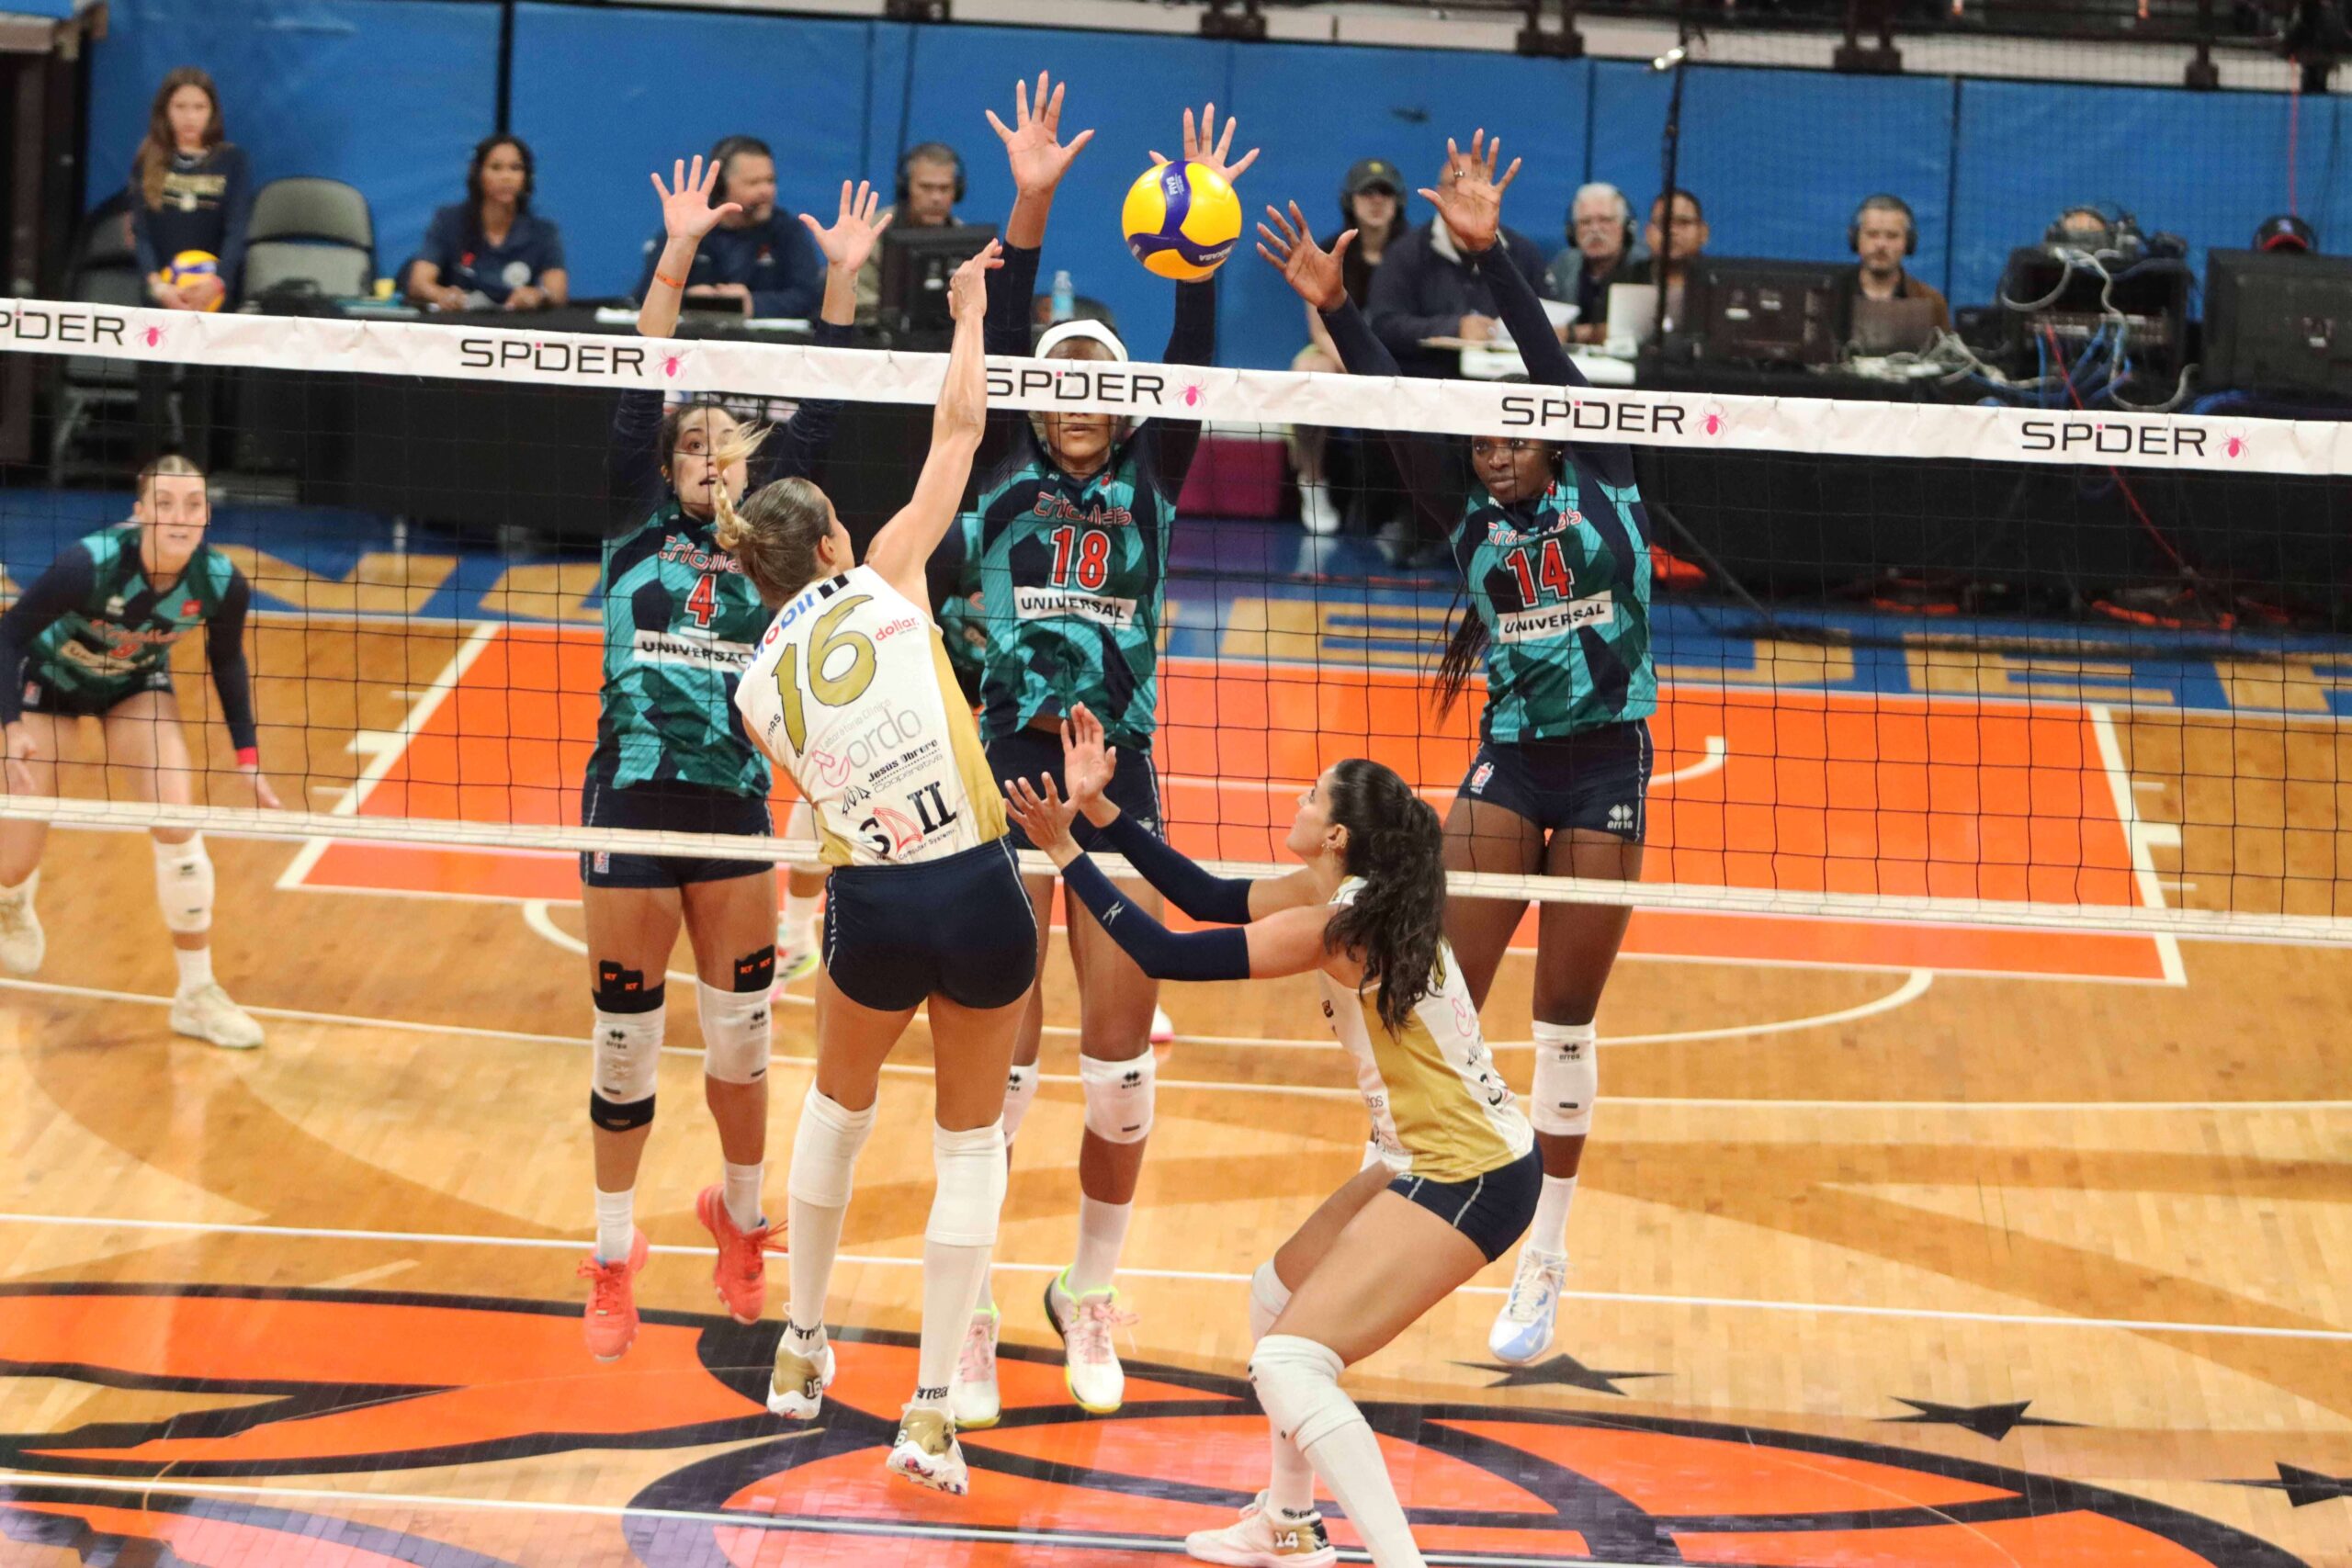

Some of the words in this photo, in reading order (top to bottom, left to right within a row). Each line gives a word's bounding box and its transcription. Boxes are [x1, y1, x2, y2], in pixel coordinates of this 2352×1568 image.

[659, 535, 743, 574] Criolla
[1050, 525, 1111, 592] 18
[1504, 538, 1575, 608] 14
[684, 573, 718, 628] 4
[1021, 596, 1125, 619] UNIVERSAL
[1504, 603, 1605, 634] UNIVERSAL
[771, 594, 877, 758] 16
[1273, 1530, 1300, 1549] 14
